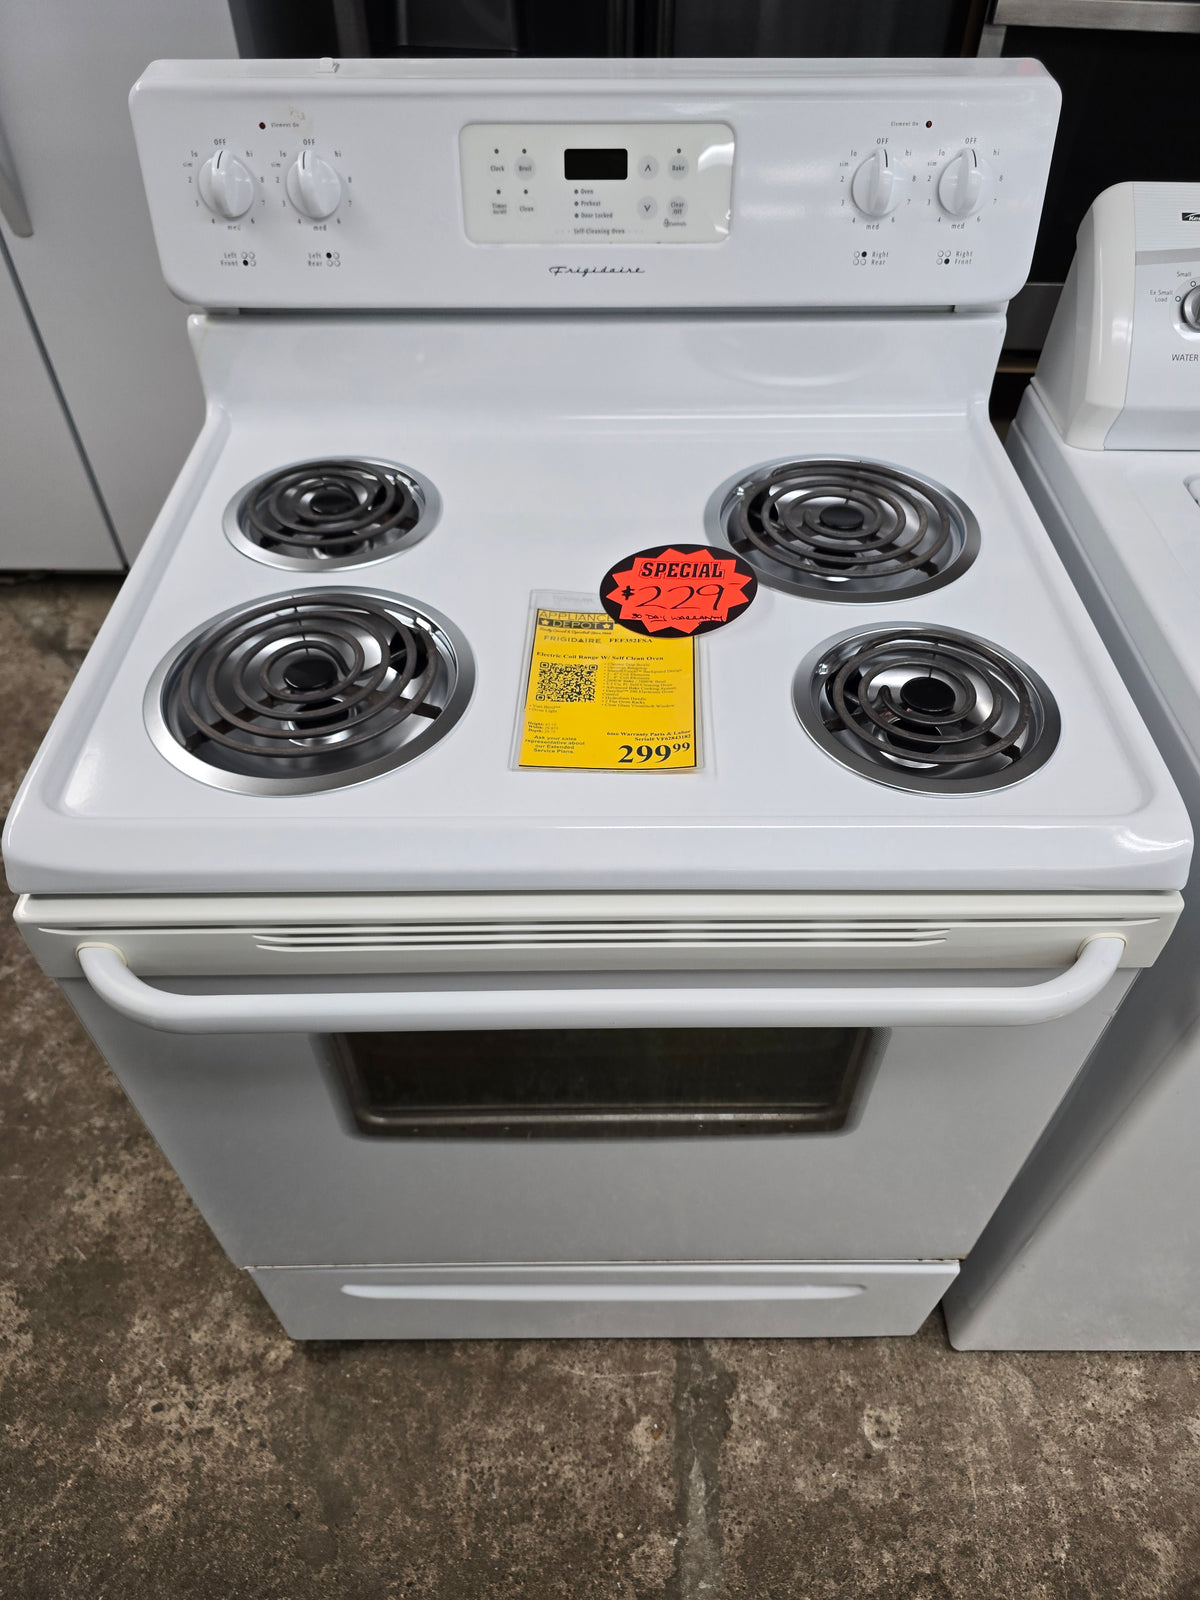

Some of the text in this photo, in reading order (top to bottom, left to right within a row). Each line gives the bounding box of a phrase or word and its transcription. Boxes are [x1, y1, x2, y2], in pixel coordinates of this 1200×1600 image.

[548, 266, 646, 278] Frigidaire
[1172, 354, 1198, 362] WATER
[640, 562, 724, 579] SPECIAL
[621, 583, 725, 611] $229
[552, 620, 598, 629] DEPOT
[544, 636, 602, 644] FRIGIDAIRE
[617, 742, 691, 764] 299 99
